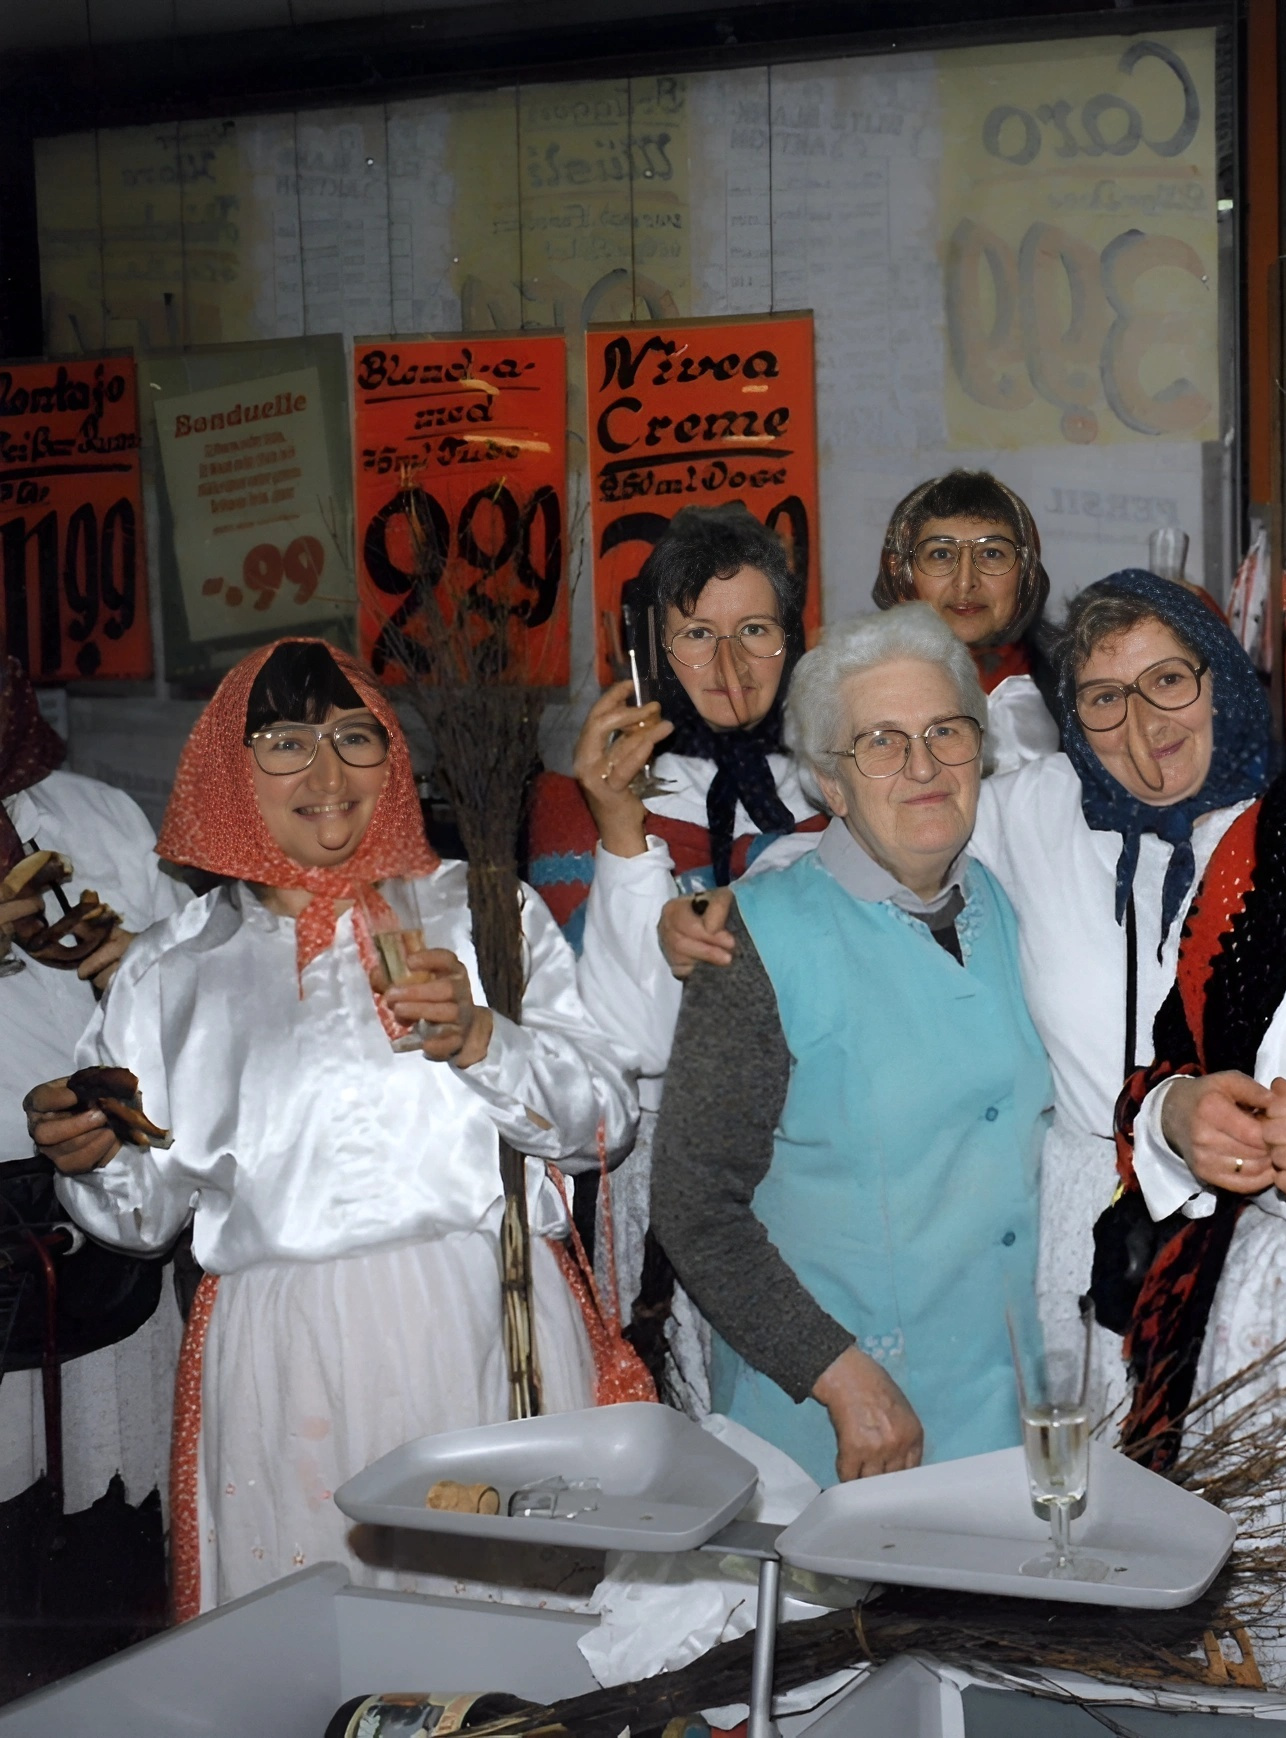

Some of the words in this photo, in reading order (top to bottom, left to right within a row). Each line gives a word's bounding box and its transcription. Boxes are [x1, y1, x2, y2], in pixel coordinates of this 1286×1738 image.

[597, 335, 781, 393] Nivea
[174, 391, 308, 438] Bonduelle
[413, 393, 494, 430] med
[597, 397, 790, 454] Creme
[701, 461, 788, 491] Dose
